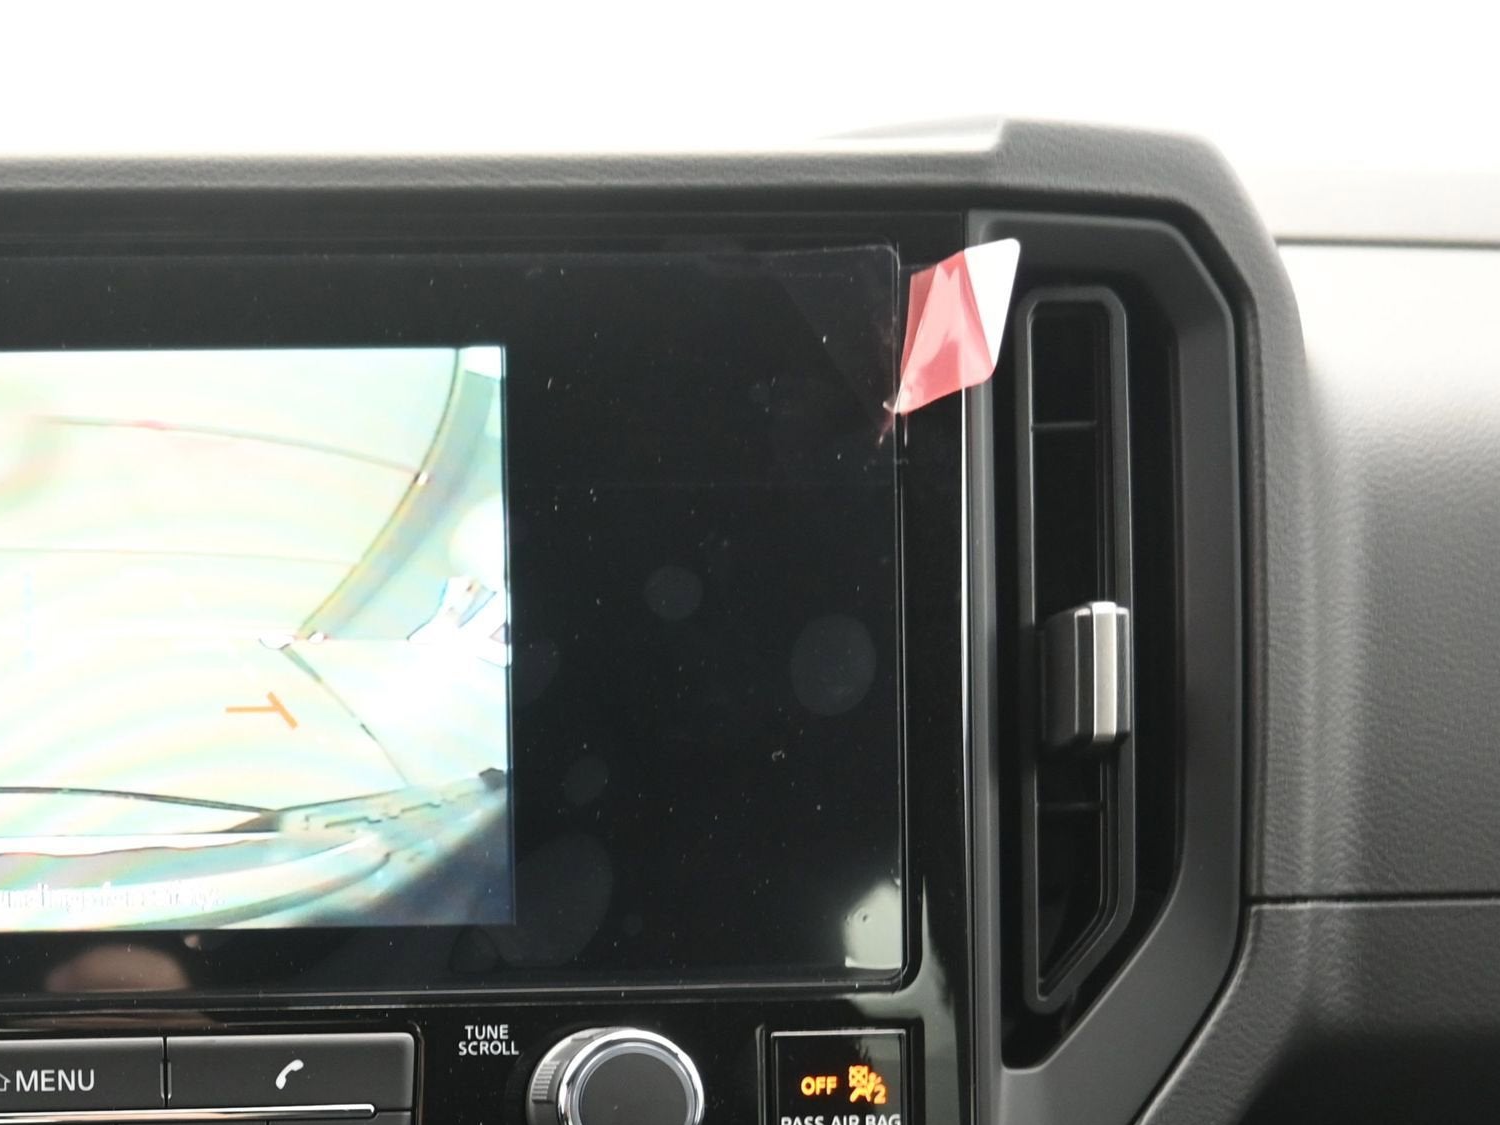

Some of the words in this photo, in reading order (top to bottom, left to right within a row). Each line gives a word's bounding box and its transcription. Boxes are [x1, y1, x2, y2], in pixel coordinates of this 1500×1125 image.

[464, 1025, 510, 1040] TUNE
[458, 1040, 520, 1056] SCROLL
[15, 1069, 96, 1093] MENU
[800, 1075, 838, 1096] OFF
